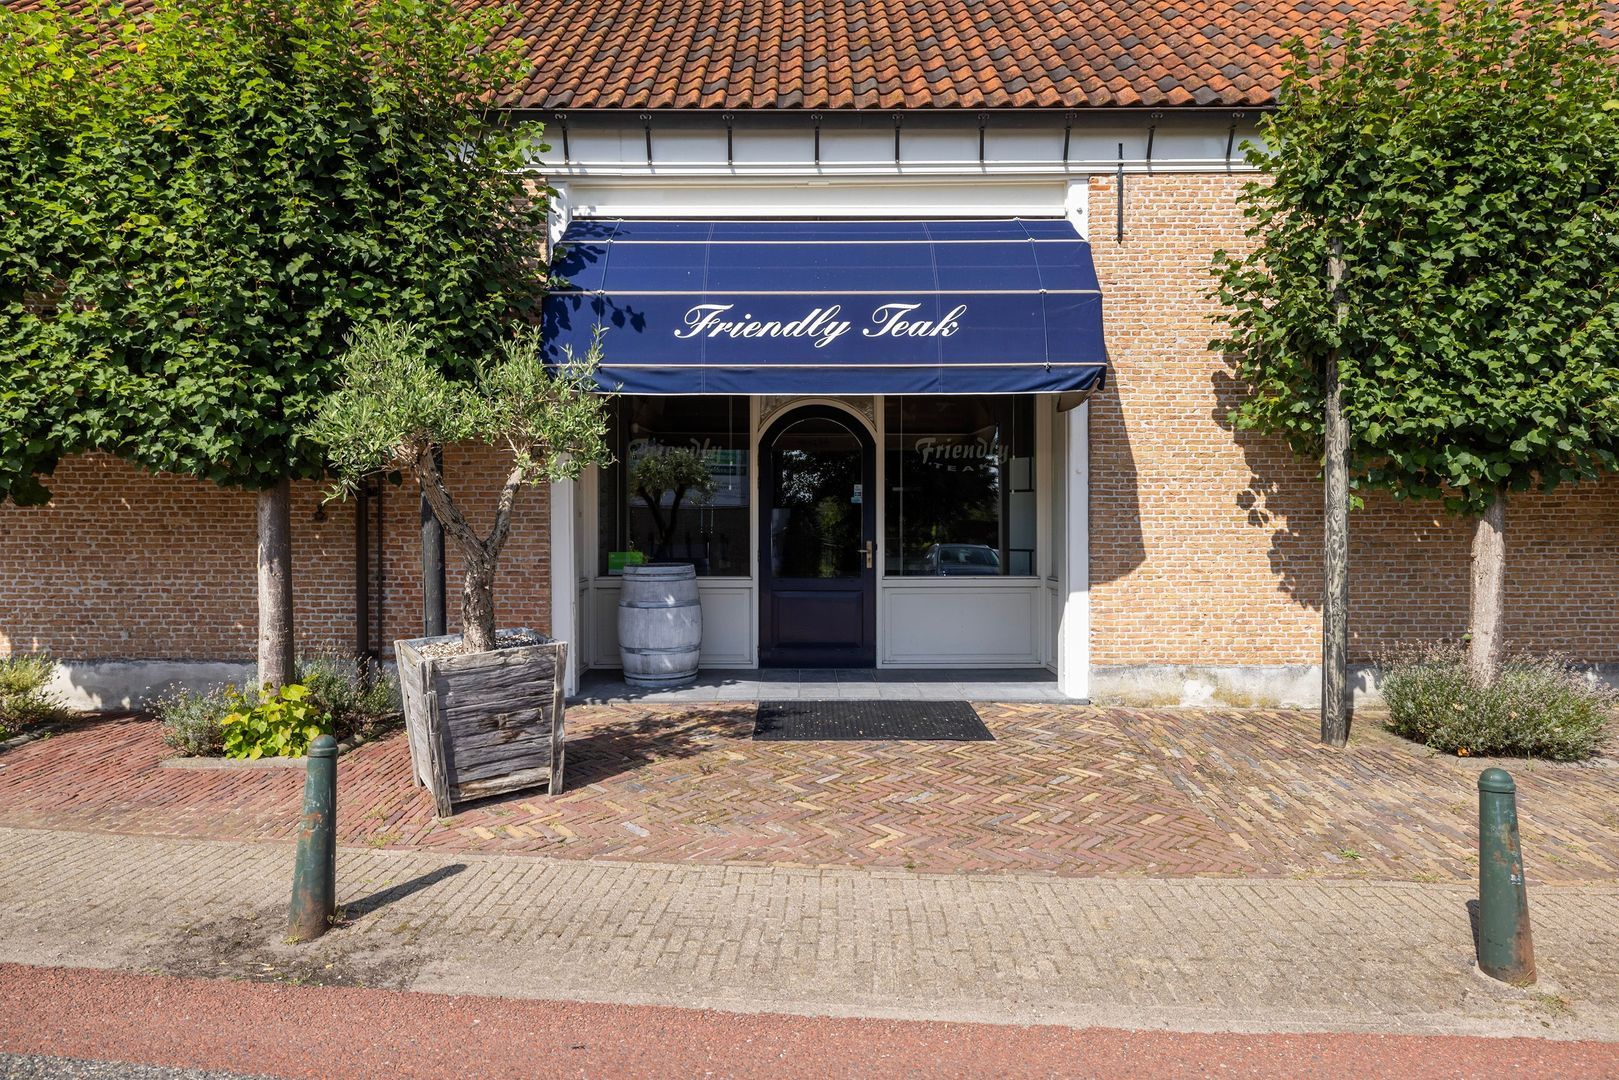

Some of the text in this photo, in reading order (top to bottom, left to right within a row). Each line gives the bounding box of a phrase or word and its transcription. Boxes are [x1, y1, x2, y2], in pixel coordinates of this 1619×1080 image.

[673, 302, 968, 348] Friendly Teak
[627, 438, 722, 464] Fiendly
[915, 437, 1009, 465] Friendly
